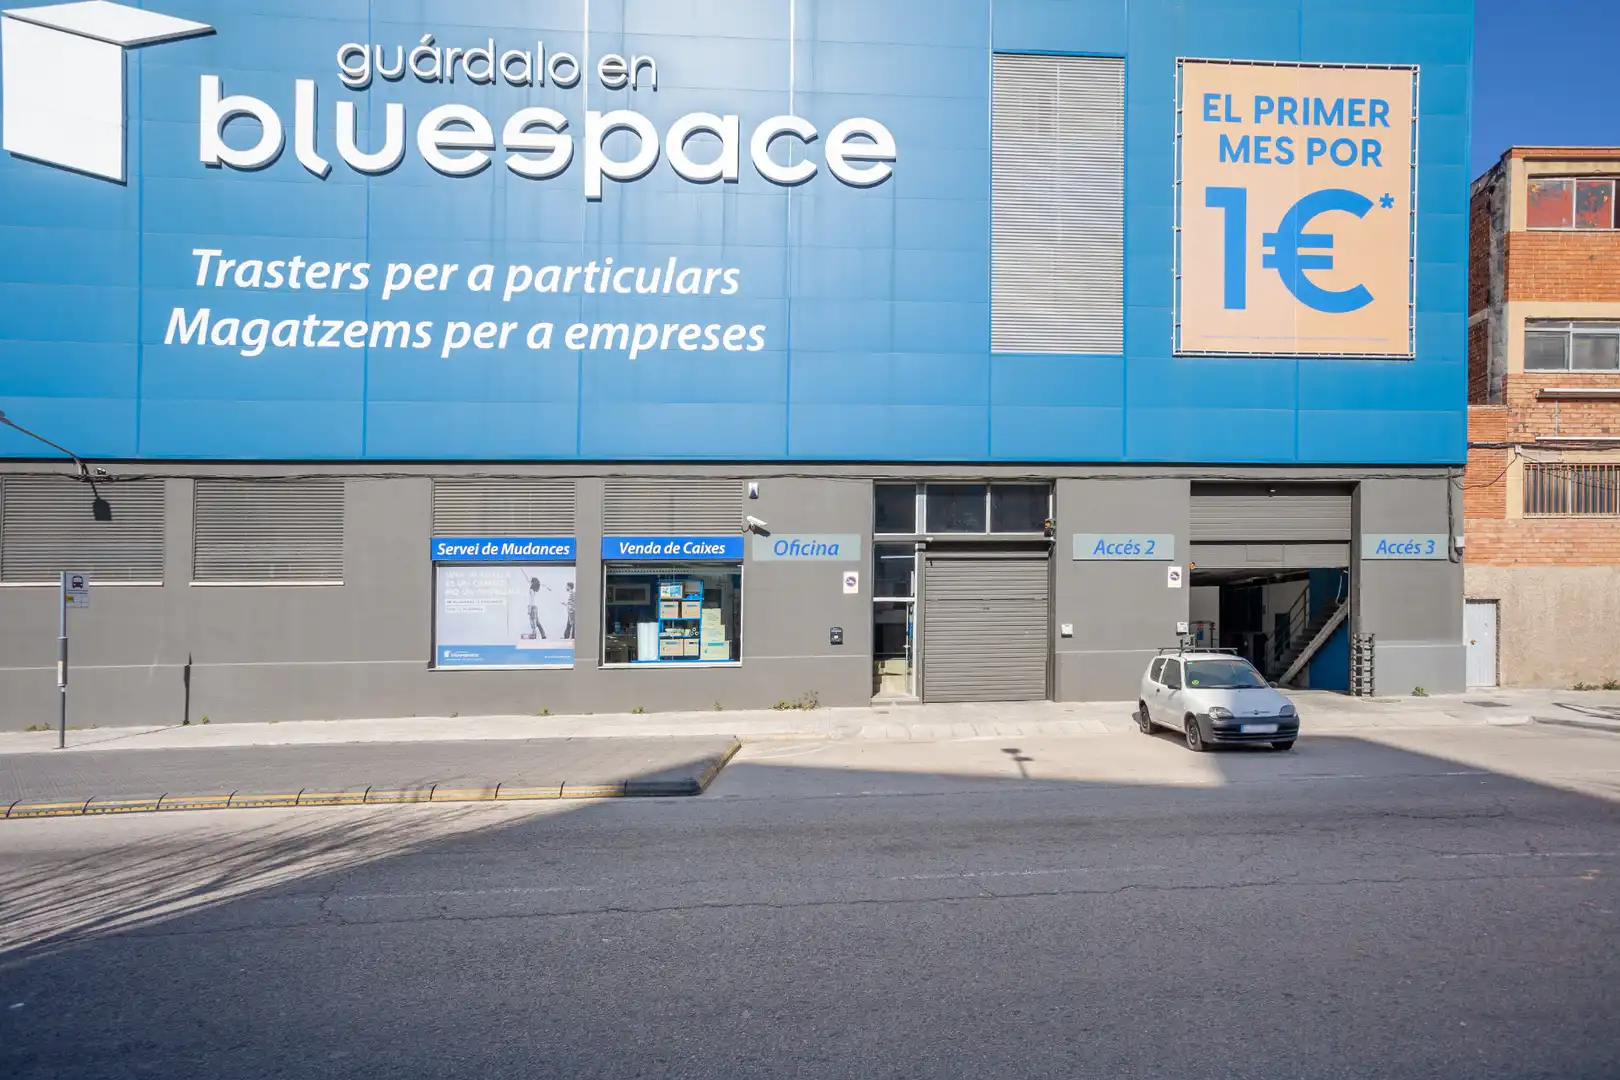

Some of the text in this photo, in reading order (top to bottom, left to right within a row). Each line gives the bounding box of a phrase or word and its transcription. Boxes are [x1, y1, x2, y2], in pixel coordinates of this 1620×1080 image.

[336, 33, 658, 92] guárdalo en
[1203, 93, 1390, 128] EL PRIMER
[199, 74, 897, 202] bluespace
[1219, 134, 1382, 167] MES POR
[192, 248, 740, 302] Trasters per a particulars
[164, 307, 766, 360] Magatzems per a empreses
[437, 541, 570, 557] Servei de Mudances
[619, 540, 725, 556] Venda de Caixes
[774, 539, 840, 556] Oficina
[1093, 536, 1156, 555] Accés 2
[1376, 537, 1436, 554] Accés 3
